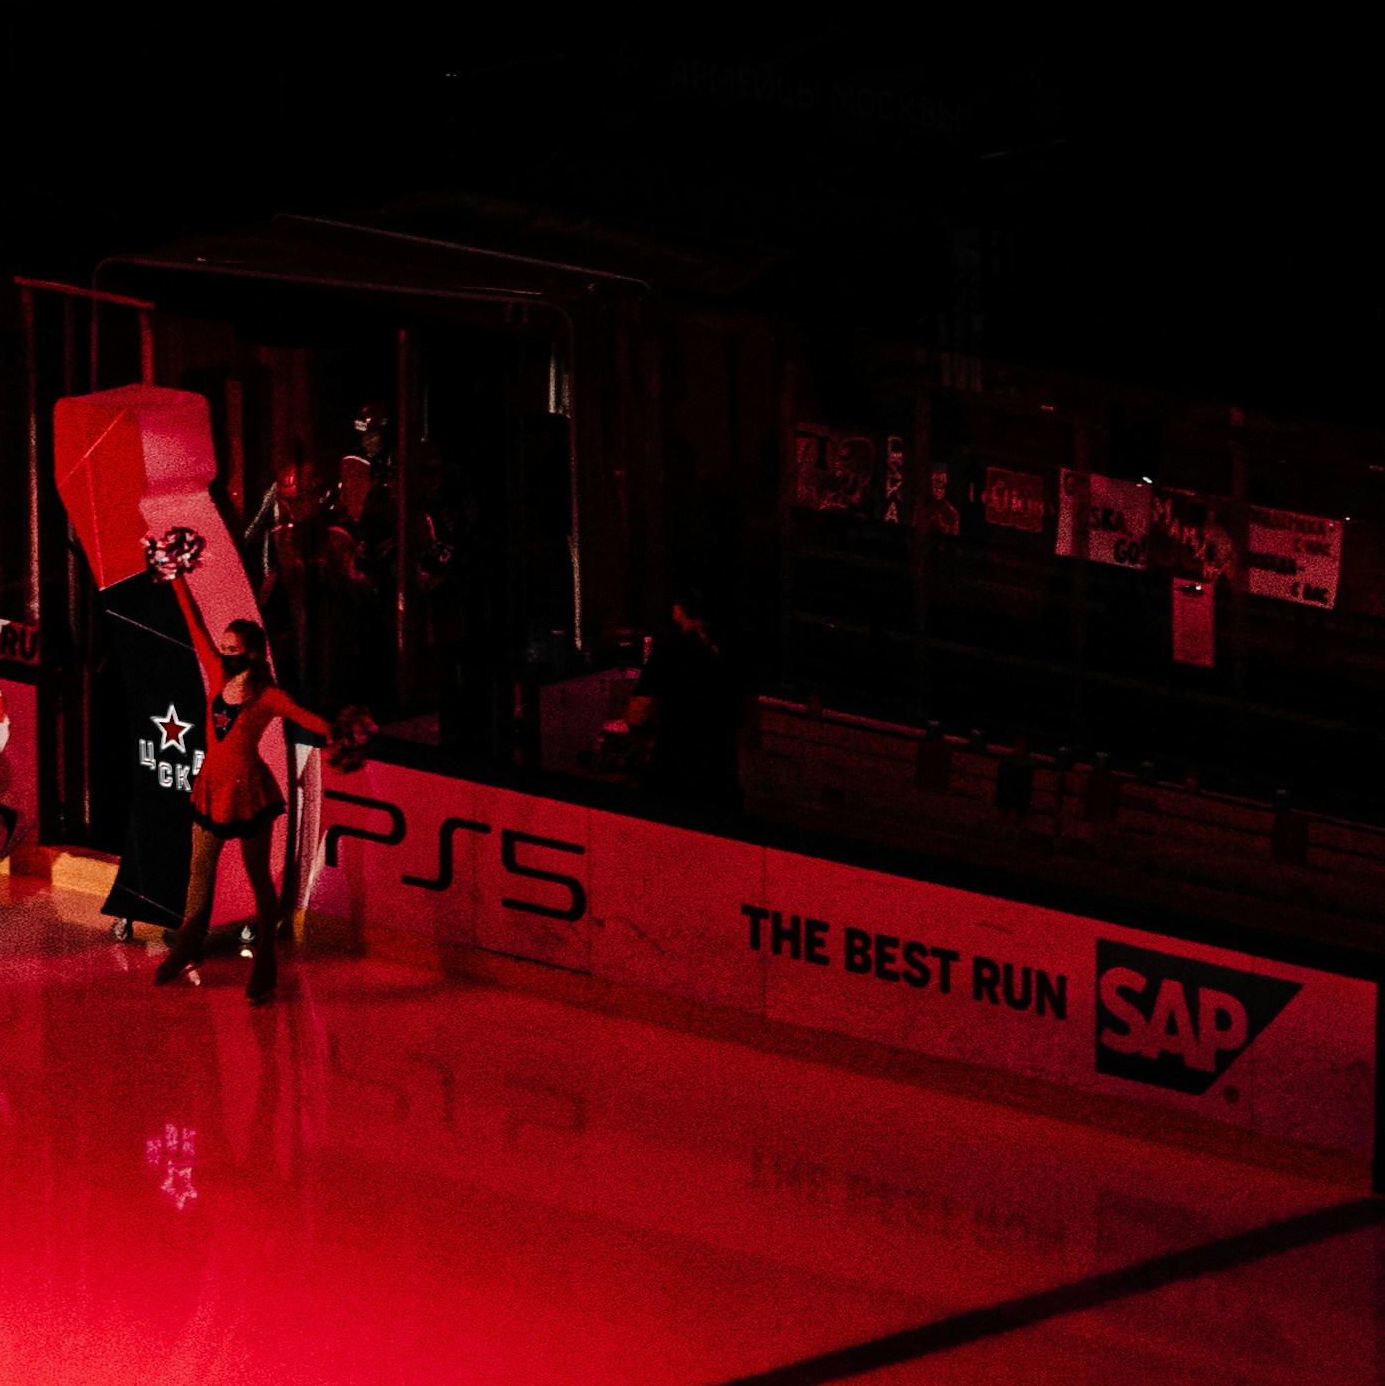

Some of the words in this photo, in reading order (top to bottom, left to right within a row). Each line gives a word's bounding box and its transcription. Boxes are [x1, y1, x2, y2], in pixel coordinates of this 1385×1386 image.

[323, 788, 587, 922] PS5
[741, 904, 830, 967] THE
[844, 926, 960, 994] BEST
[972, 956, 1067, 1020] RUN
[1098, 965, 1251, 1073] SAP
